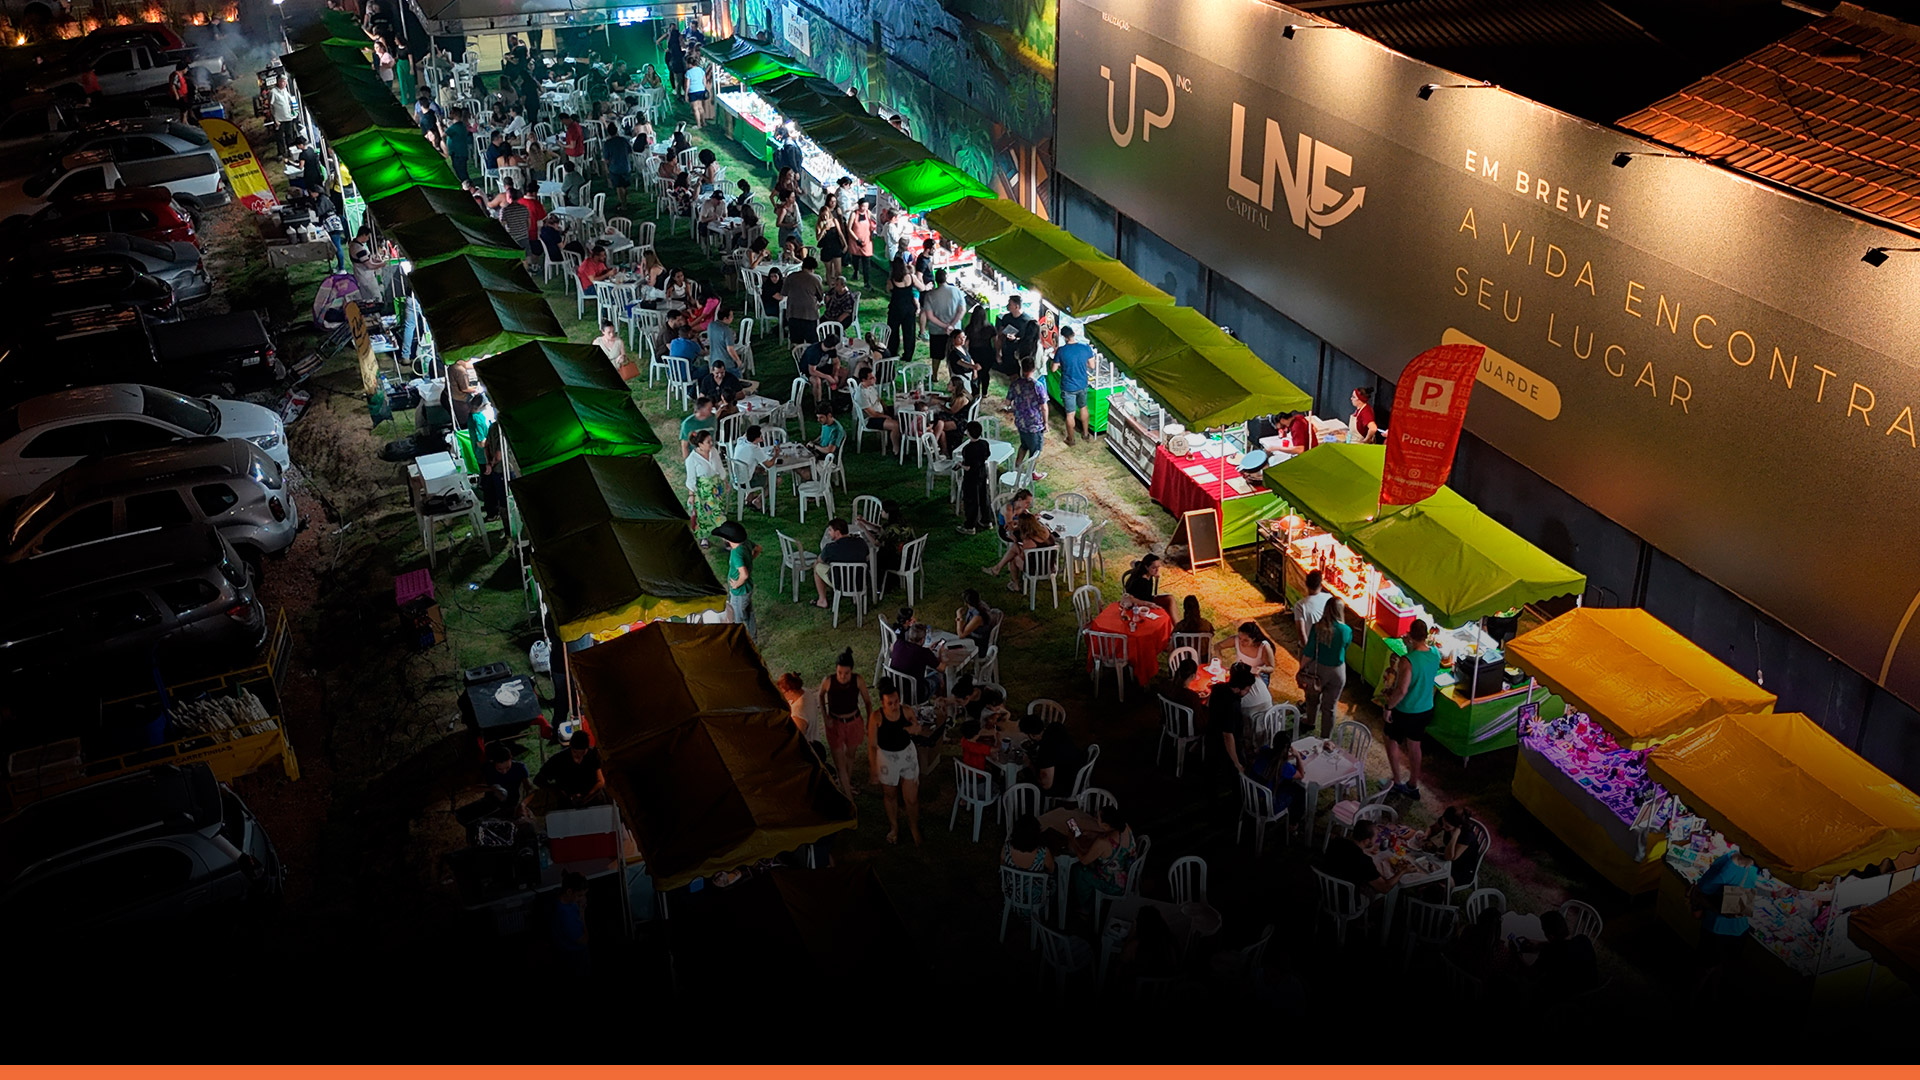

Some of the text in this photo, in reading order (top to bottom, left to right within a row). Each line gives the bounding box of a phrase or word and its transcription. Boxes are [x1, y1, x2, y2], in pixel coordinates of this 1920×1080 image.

[1176, 74, 1192, 94] INC.
[1465, 149, 1612, 229] EM BREVE
[1226, 195, 1270, 232] CAPITAL
[1454, 266, 1693, 415] SEU LUGAR
[1459, 207, 1917, 449] A VIDA ENCONTRA
[1419, 381, 1444, 406] P
[1482, 357, 1539, 401] UARDE
[1401, 433, 1445, 450] Piacere
